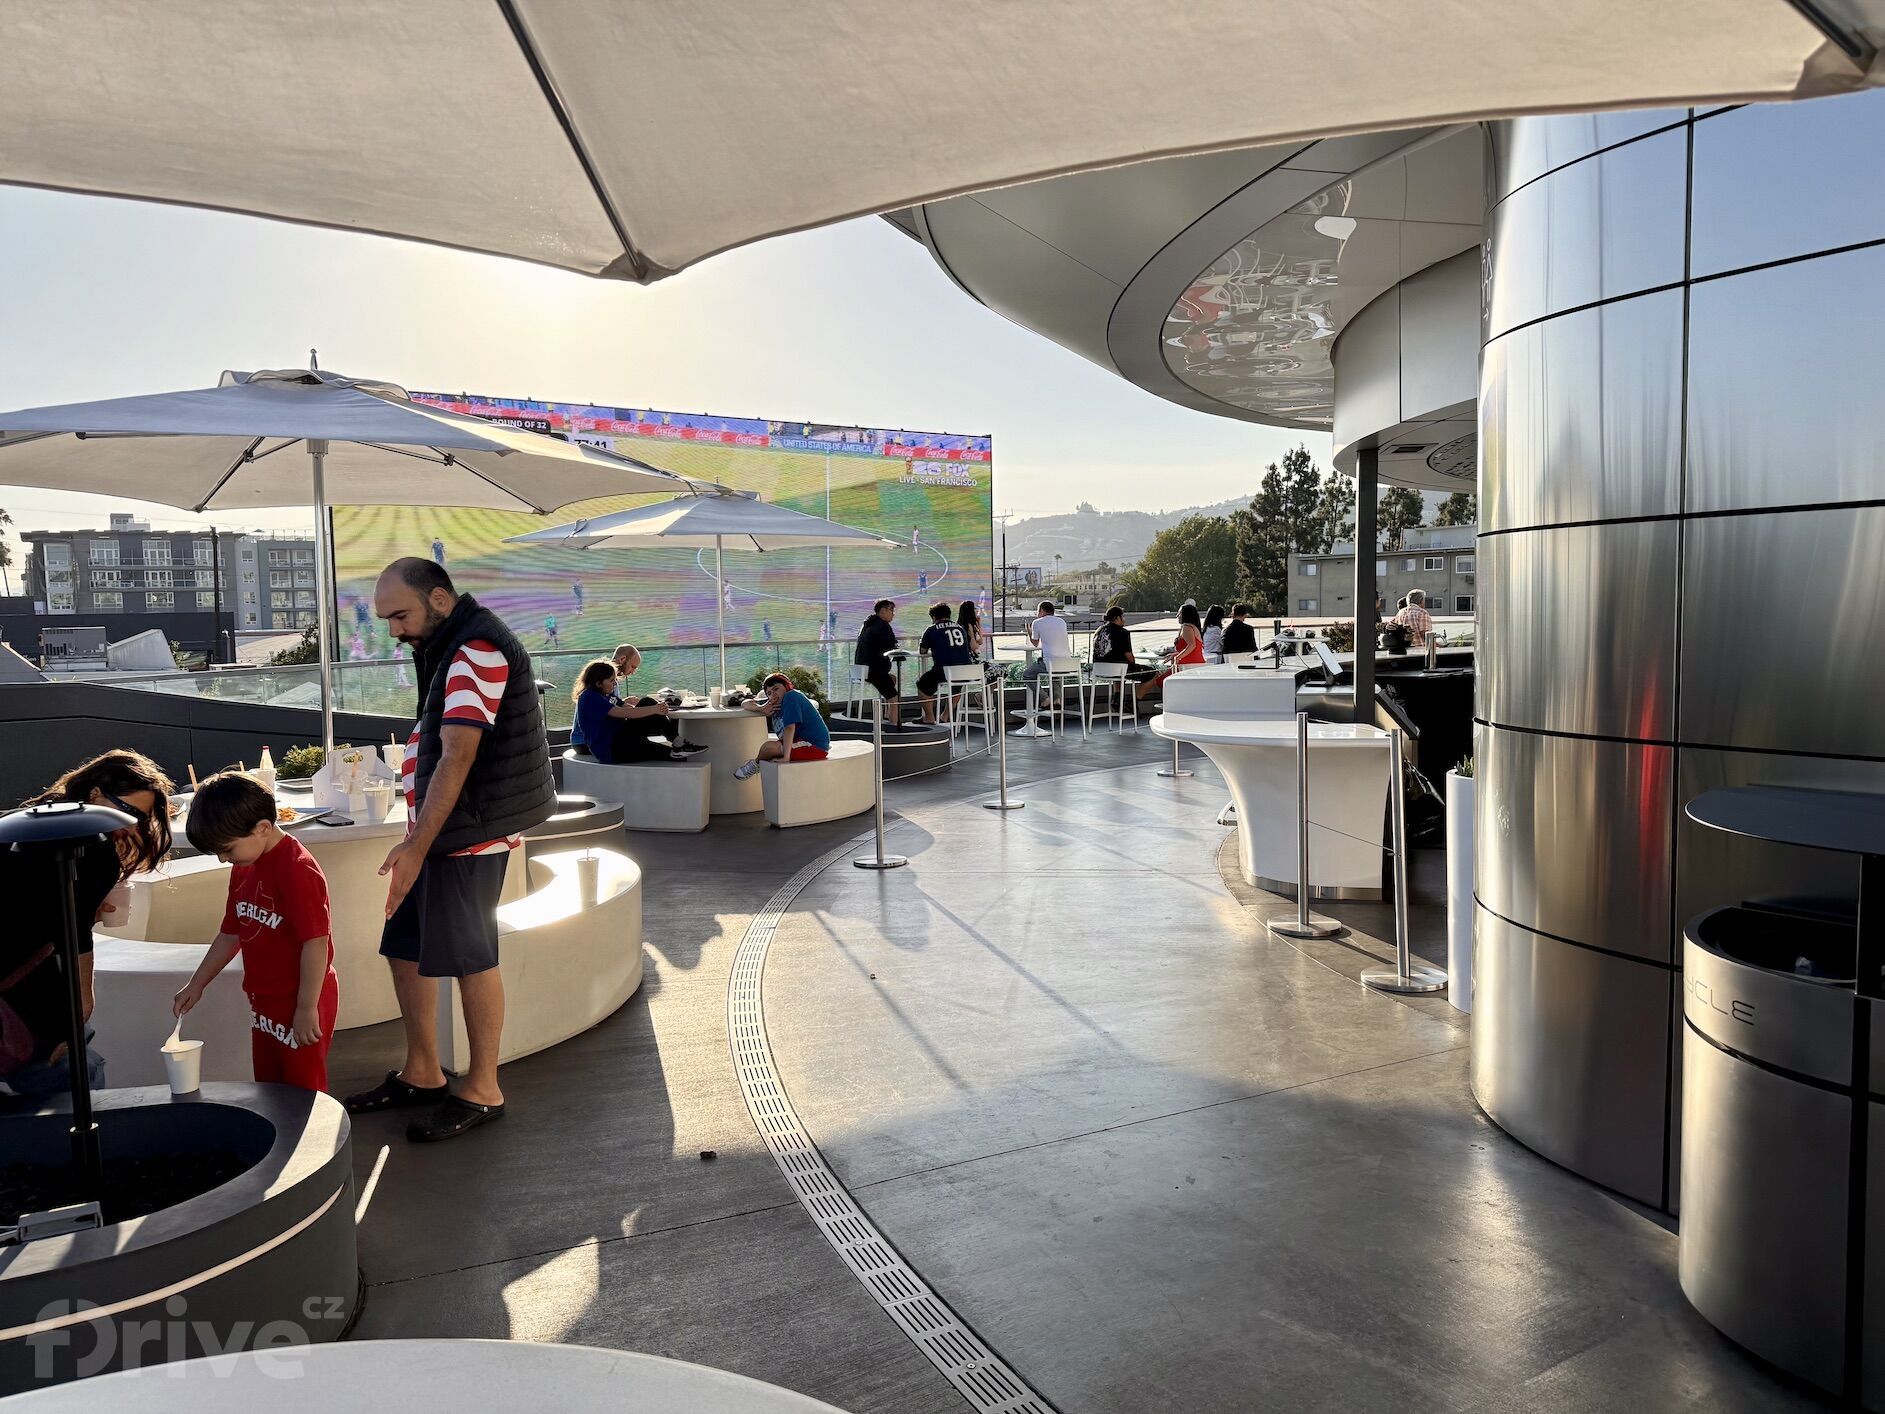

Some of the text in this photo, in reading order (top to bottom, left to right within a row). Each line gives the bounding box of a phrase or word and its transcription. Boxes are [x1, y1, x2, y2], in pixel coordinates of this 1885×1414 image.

[524, 420, 535, 428] OF
[537, 421, 546, 429] 32
[783, 439, 871, 453] UNITED STATES OF AMERICA
[900, 475, 977, 487] LIVE SAN FRANCISCO
[945, 629, 964, 646] 19
